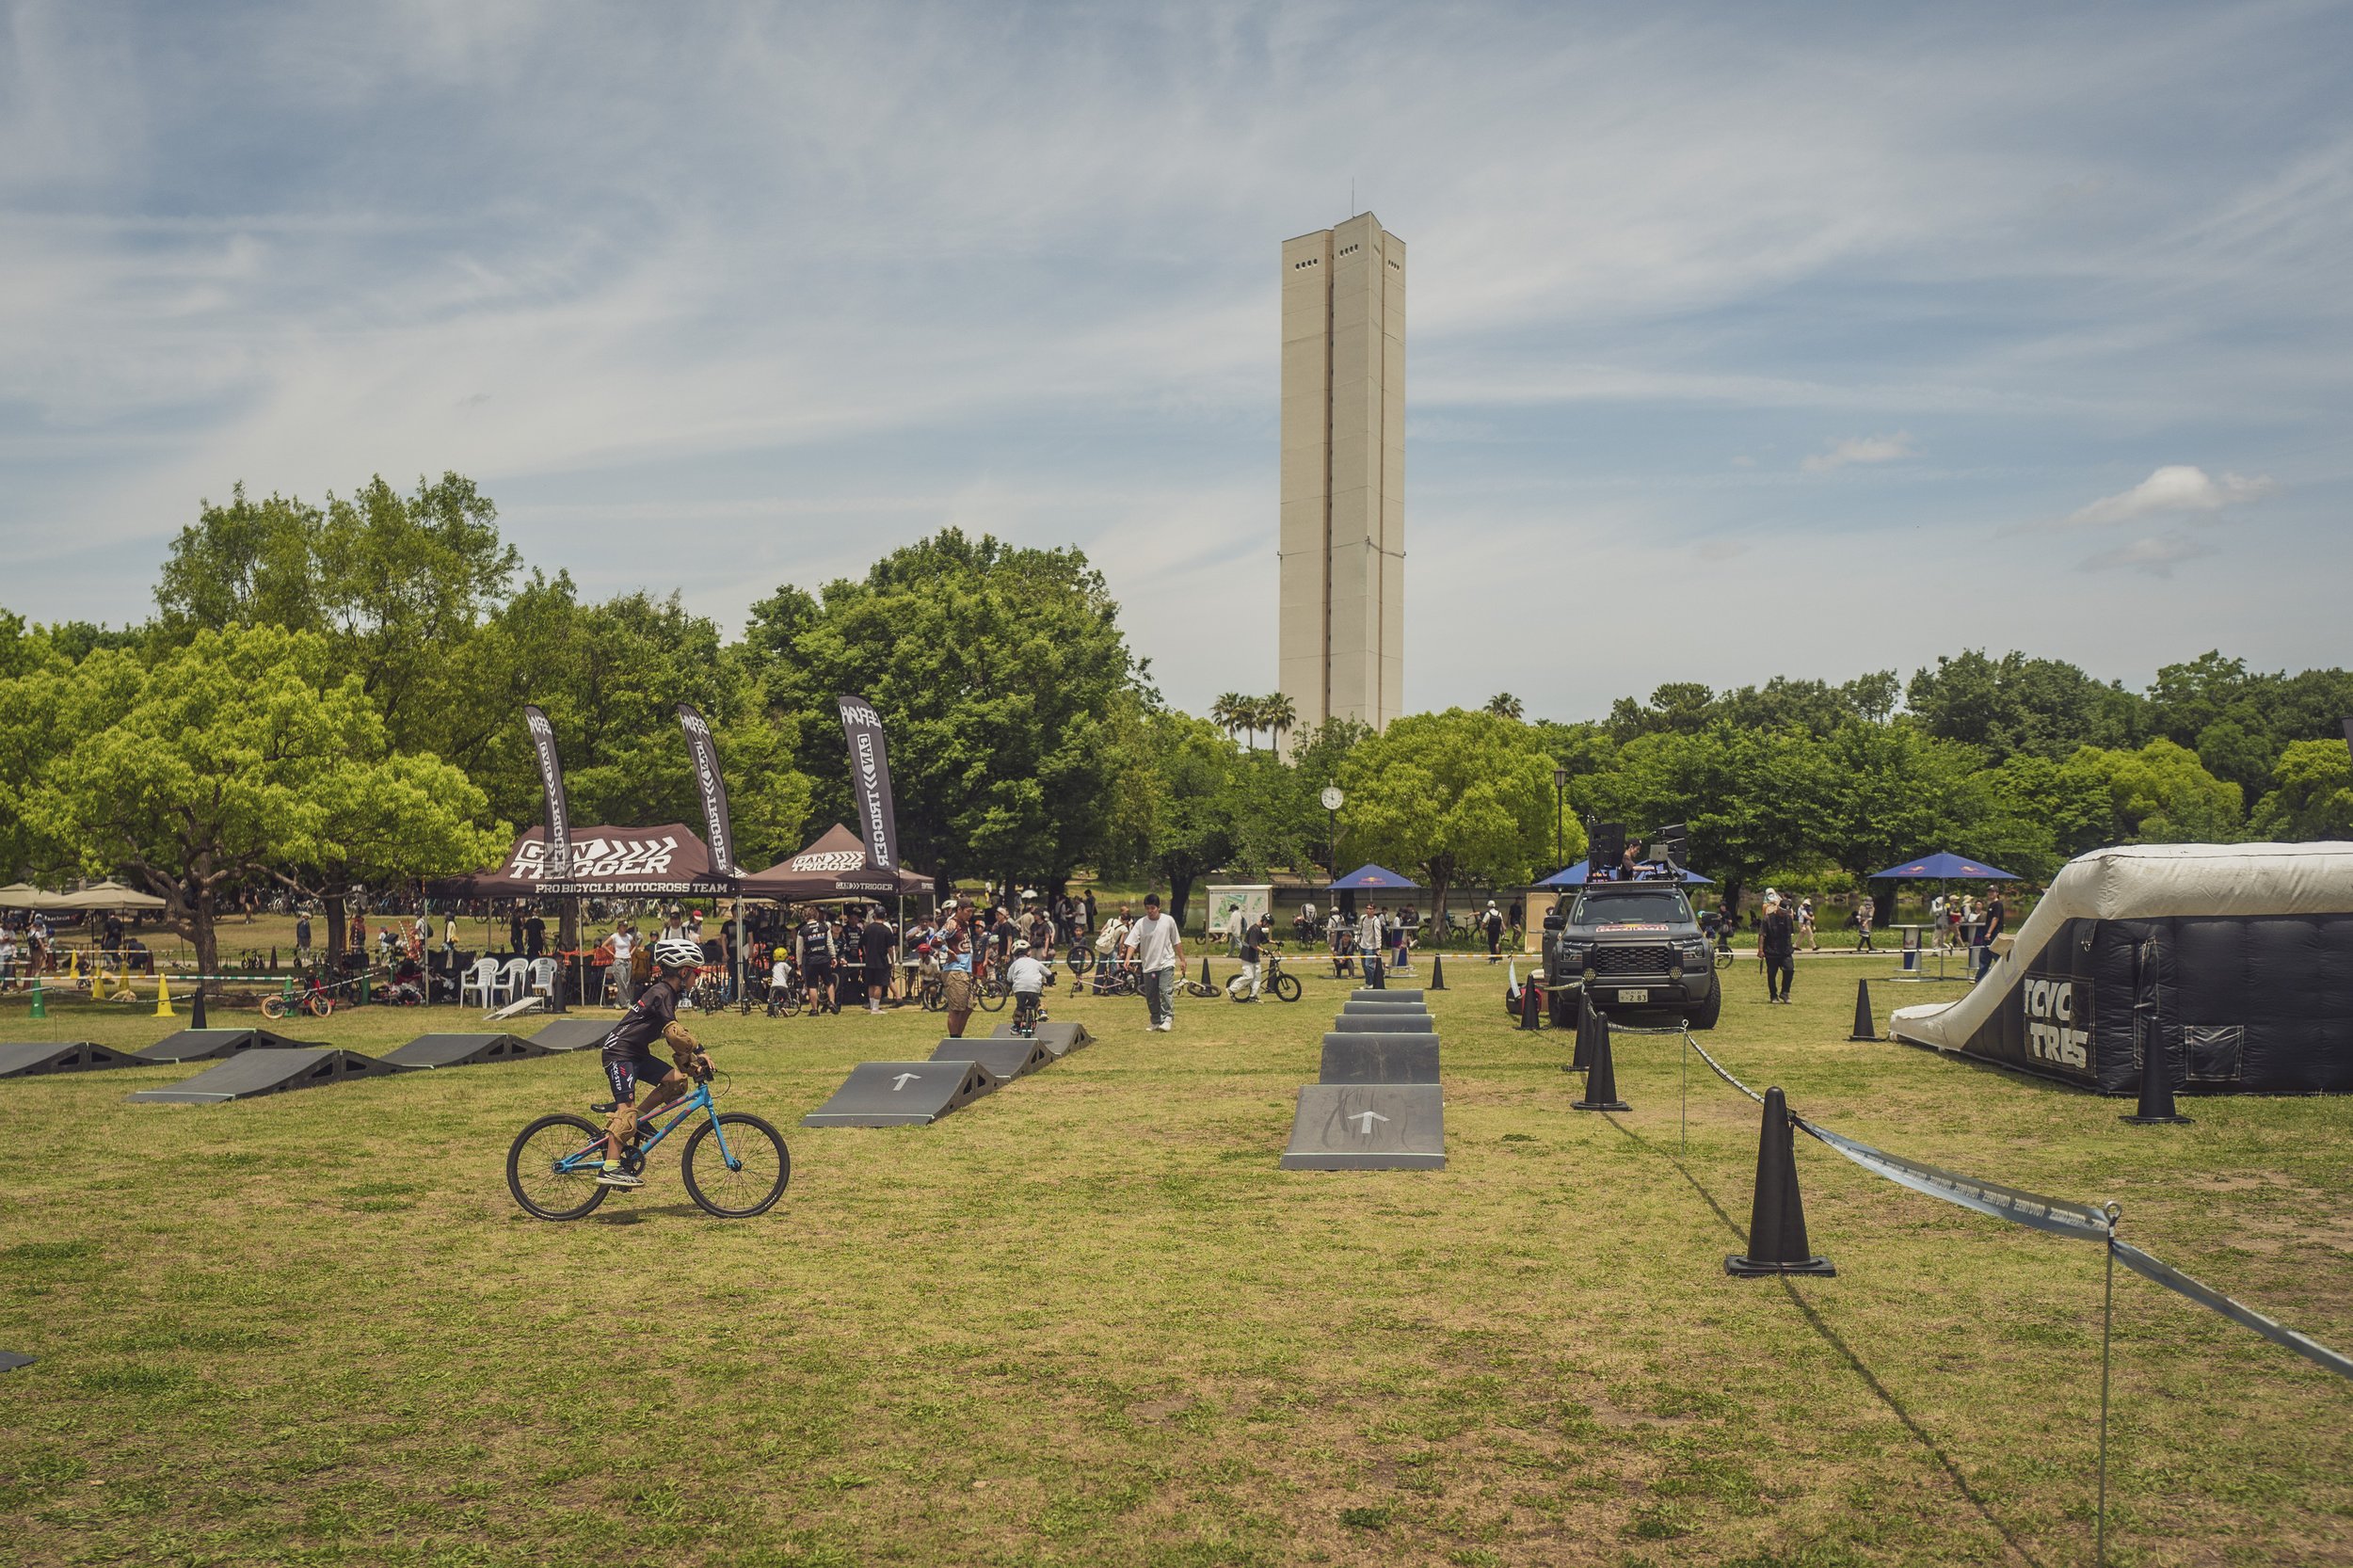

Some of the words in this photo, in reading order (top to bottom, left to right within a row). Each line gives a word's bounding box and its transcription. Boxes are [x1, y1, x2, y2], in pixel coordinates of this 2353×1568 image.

[796, 855, 825, 864] GAN
[792, 862, 862, 872] TRIGGER
[536, 884, 560, 894] PRO
[561, 883, 613, 893] BICYCLE
[616, 883, 690, 893] MOTOCROSS
[693, 884, 728, 893] TEAM
